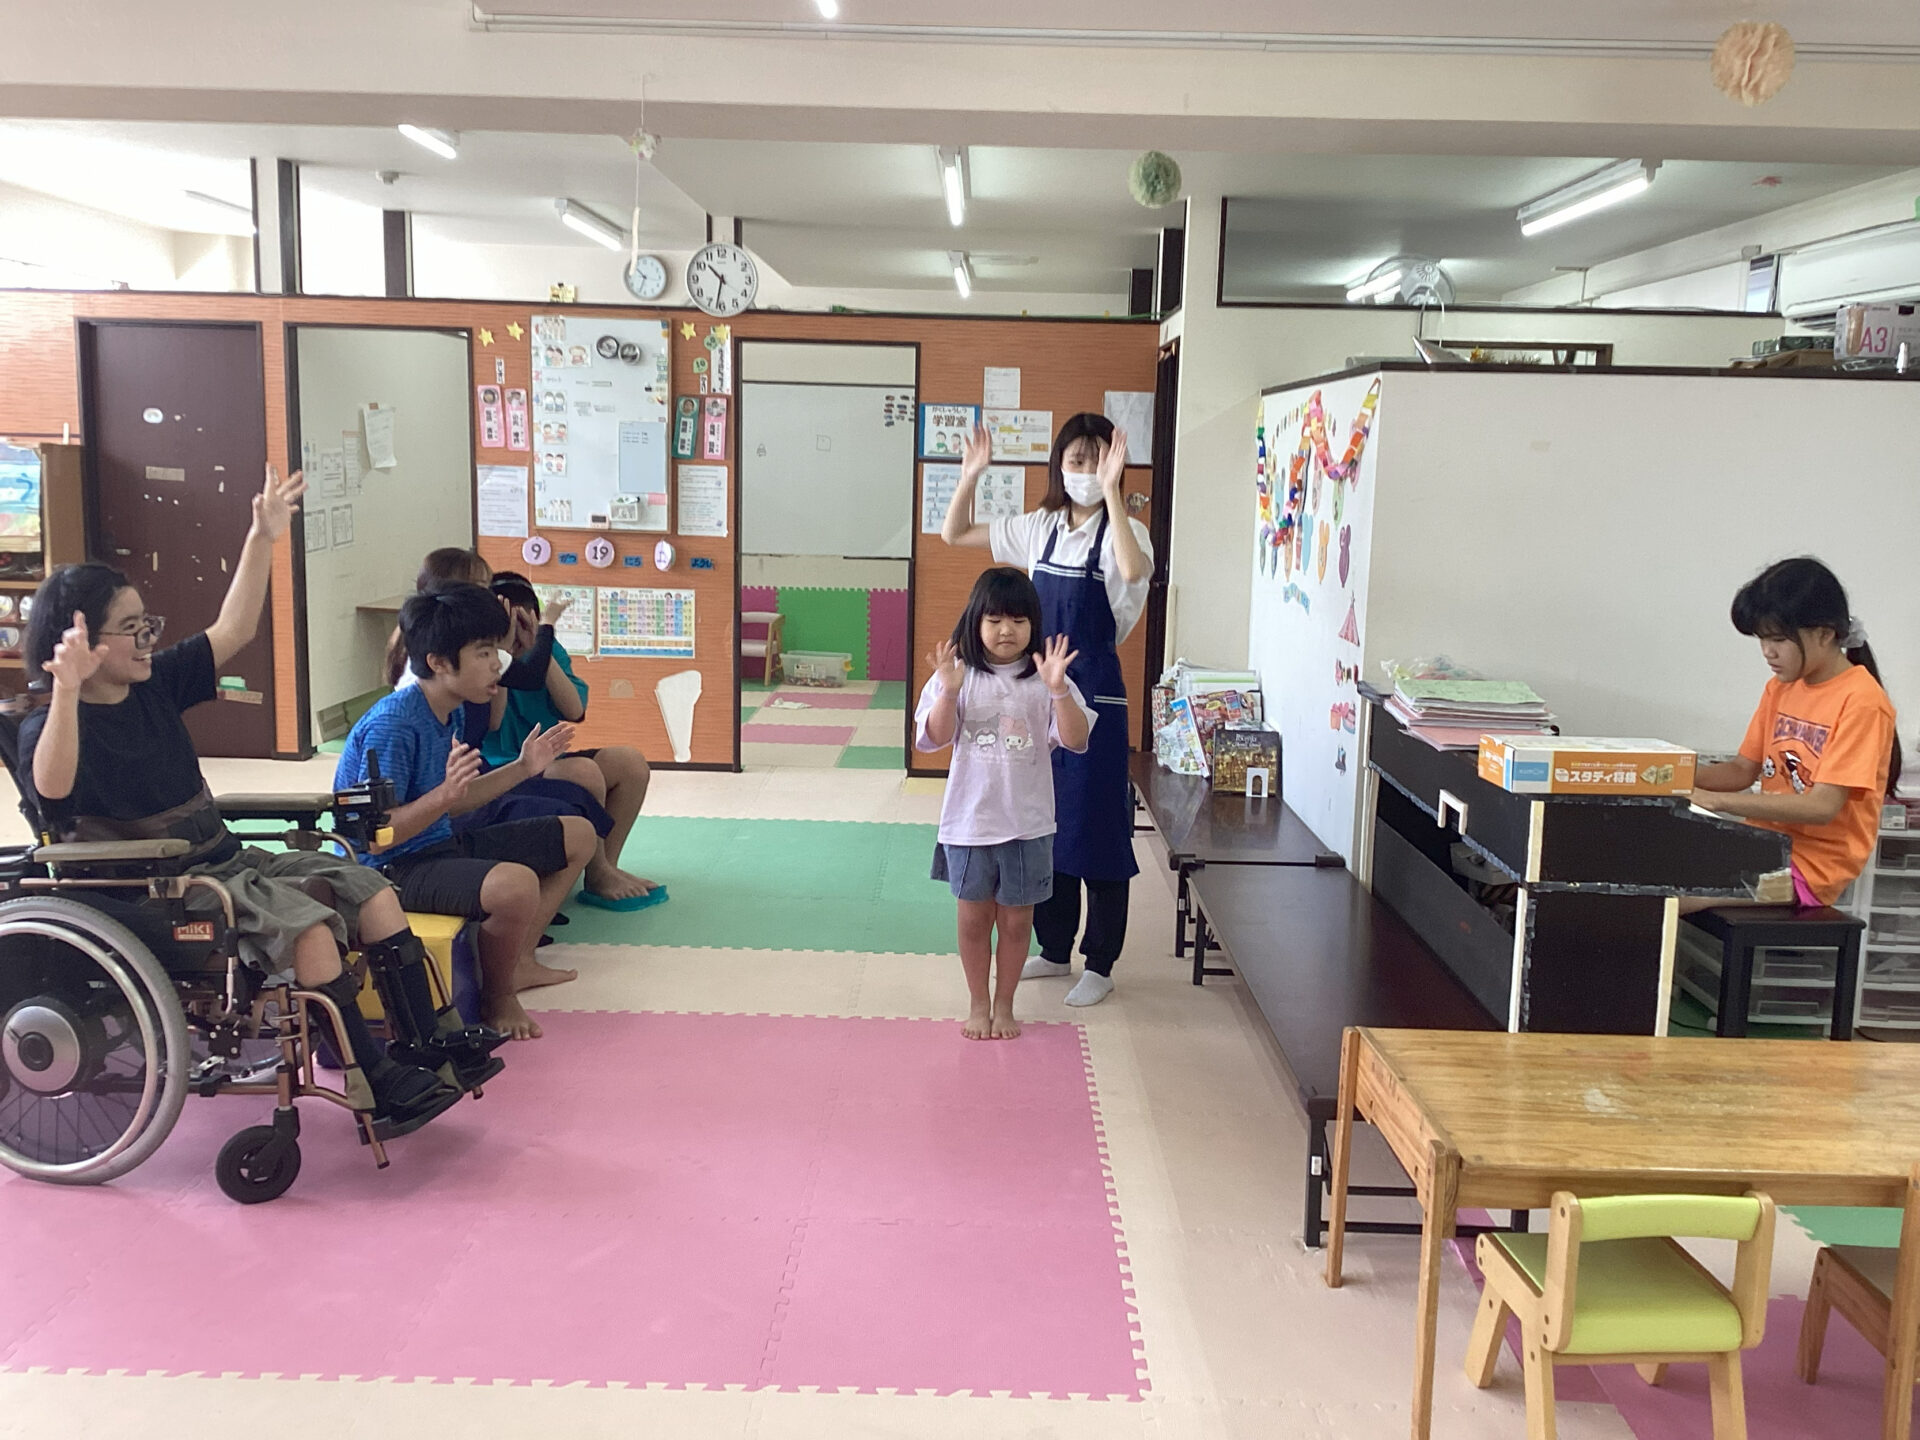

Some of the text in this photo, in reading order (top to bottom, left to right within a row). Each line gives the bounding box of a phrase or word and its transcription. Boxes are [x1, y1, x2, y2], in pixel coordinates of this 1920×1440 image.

[706, 252, 713, 261] 11
[717, 248, 727, 258] 12
[732, 252, 737, 262] 1
[696, 261, 706, 271] 10
[741, 262, 748, 272] 2
[692, 274, 699, 284] 9
[745, 275, 752, 286] 3
[696, 288, 703, 298] 8
[741, 289, 748, 298] 4
[706, 297, 713, 307] 7
[719, 301, 726, 312] 6
[732, 298, 739, 309] 5
[1860, 326, 1888, 353] A3
[932, 406, 967, 415] がくしゅうしつ
[932, 415, 968, 428] 学習室
[531, 543, 542, 560] 9
[592, 546, 609, 560] 19
[1569, 769, 1638, 784] スタディ将棋
